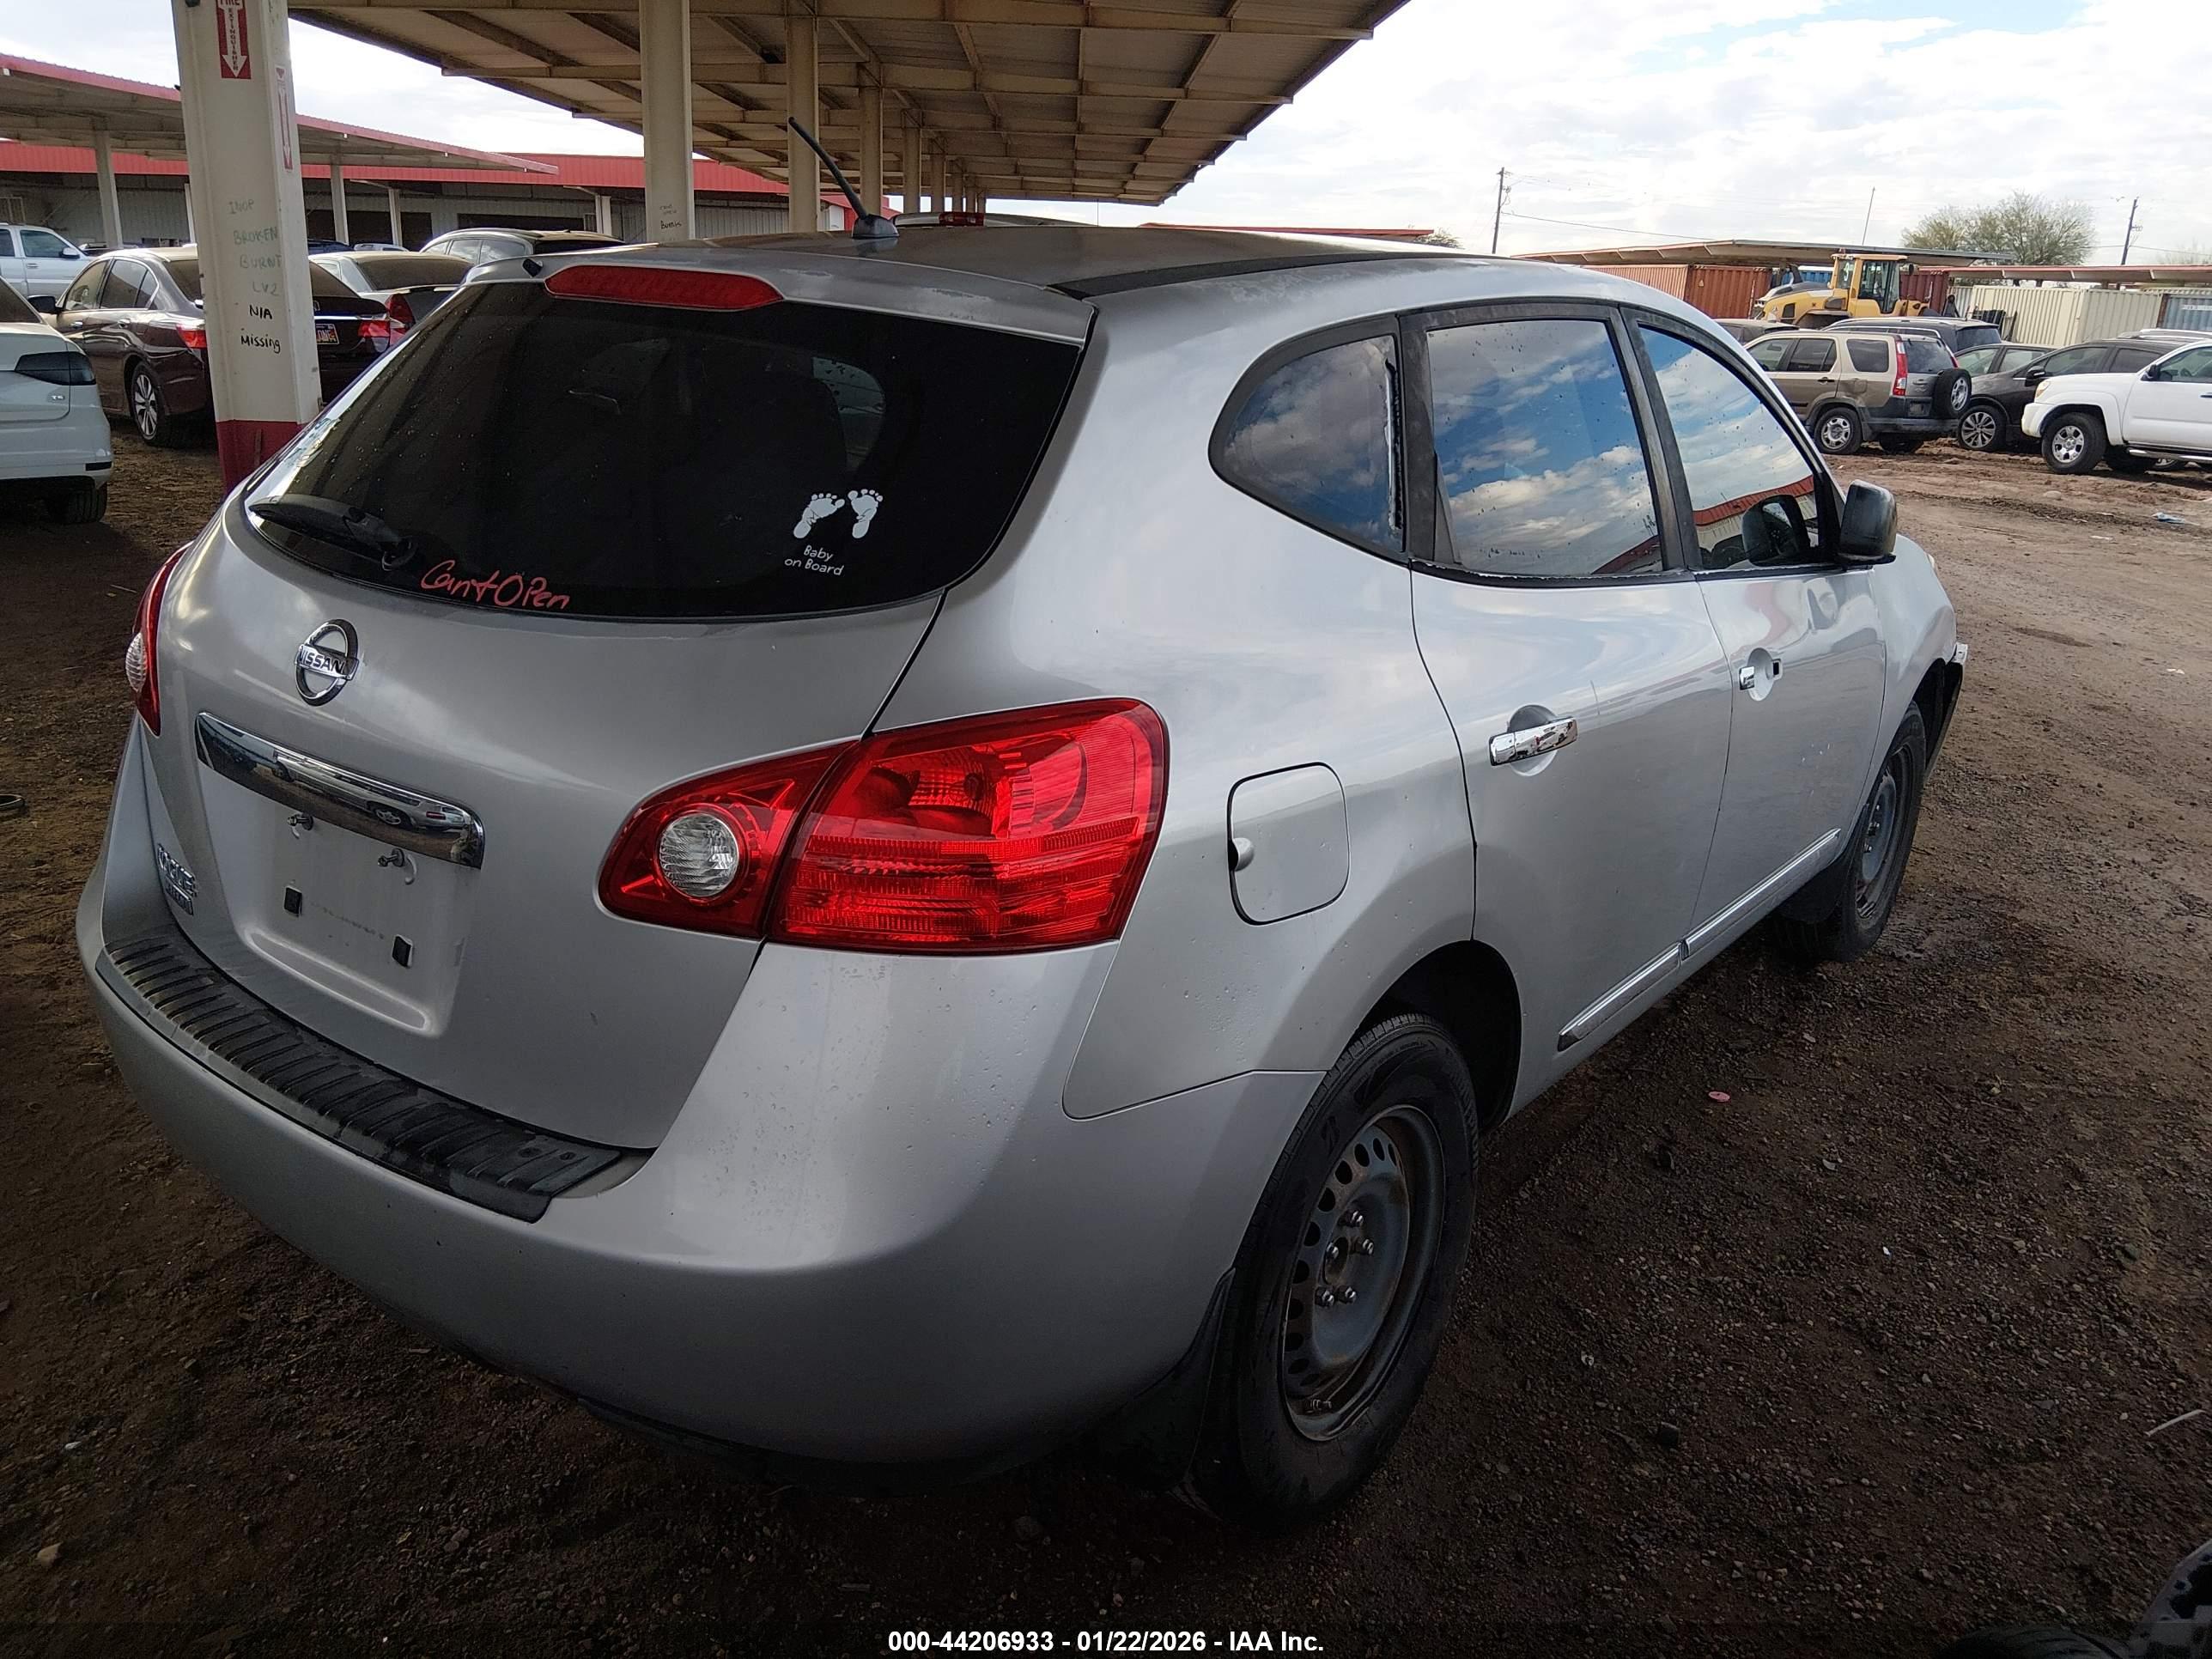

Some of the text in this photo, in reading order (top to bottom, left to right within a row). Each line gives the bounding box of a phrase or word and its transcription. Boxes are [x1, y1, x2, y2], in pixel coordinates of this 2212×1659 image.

[240, 333, 282, 355] Missing
[804, 544, 833, 562] Baby
[784, 558, 845, 575] on Board
[298, 645, 346, 675] NISSAN
